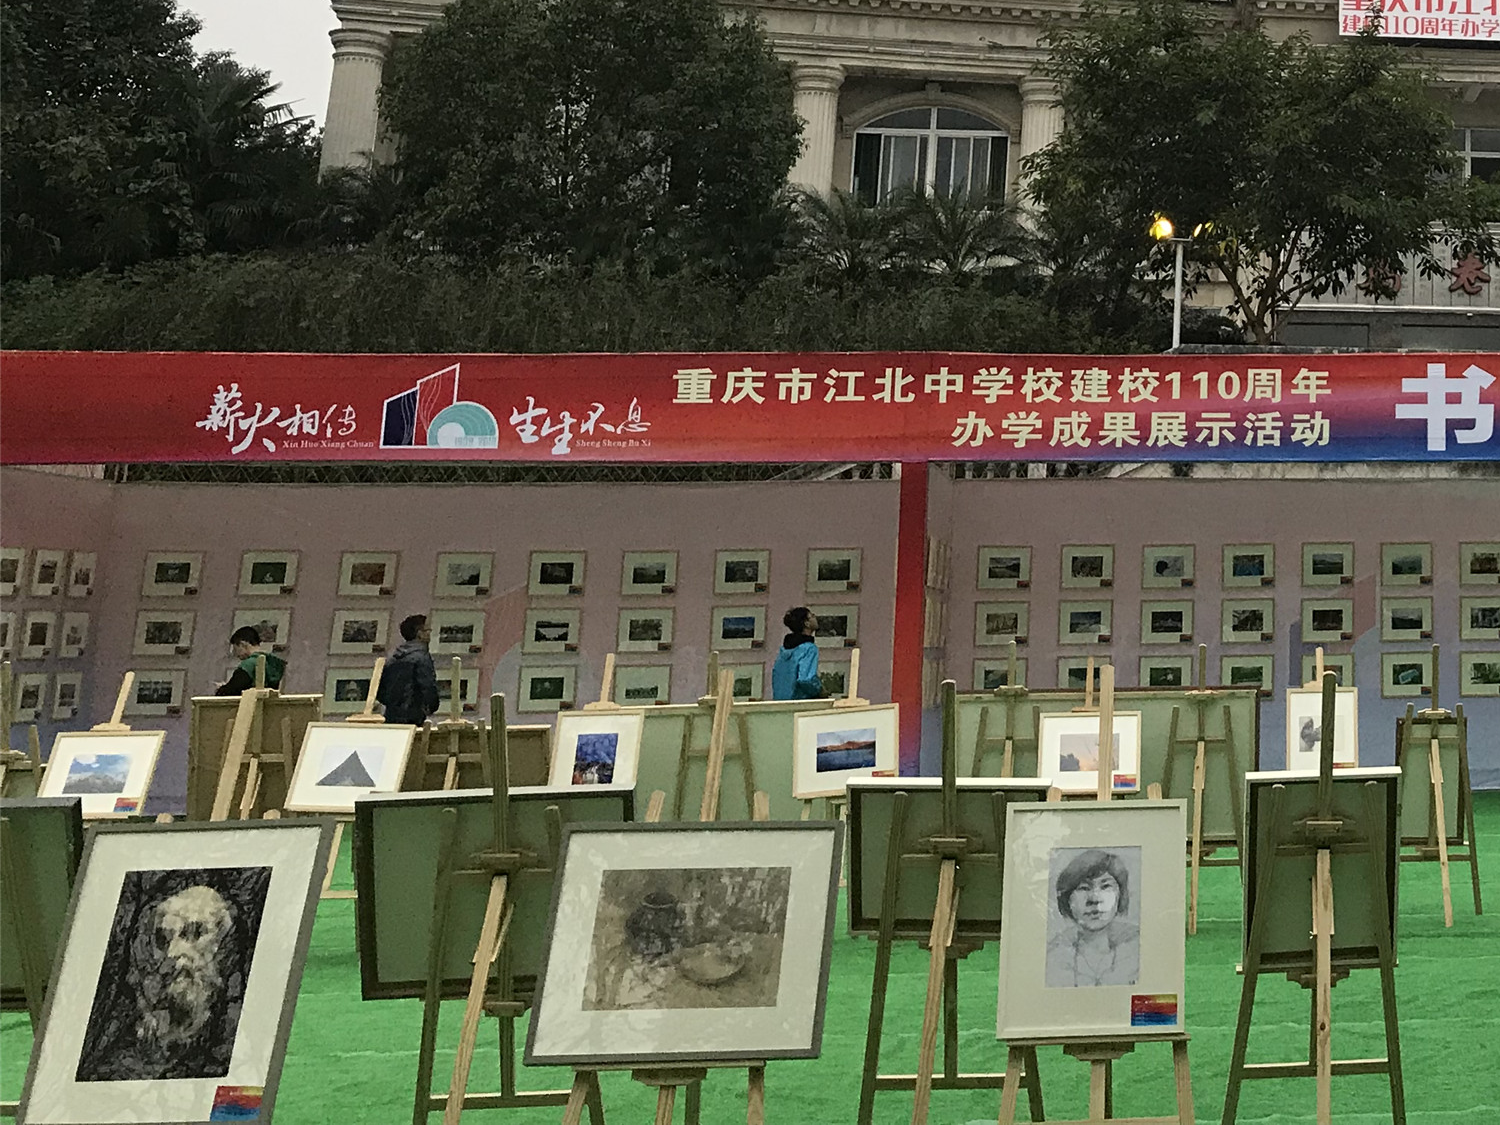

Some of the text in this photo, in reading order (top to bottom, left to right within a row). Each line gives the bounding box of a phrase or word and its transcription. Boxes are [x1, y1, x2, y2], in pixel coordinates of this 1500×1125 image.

[671, 367, 1333, 404] 重庆市江北中学校建校110周年
[195, 382, 358, 454] 薪火相传
[509, 395, 653, 455] 生生不息
[950, 410, 1331, 448] 办学成果展示活动
[282, 440, 374, 450] Xin Huo Xiang Chuan
[575, 439, 600, 448] Sheng
[602, 439, 627, 448] Sheng
